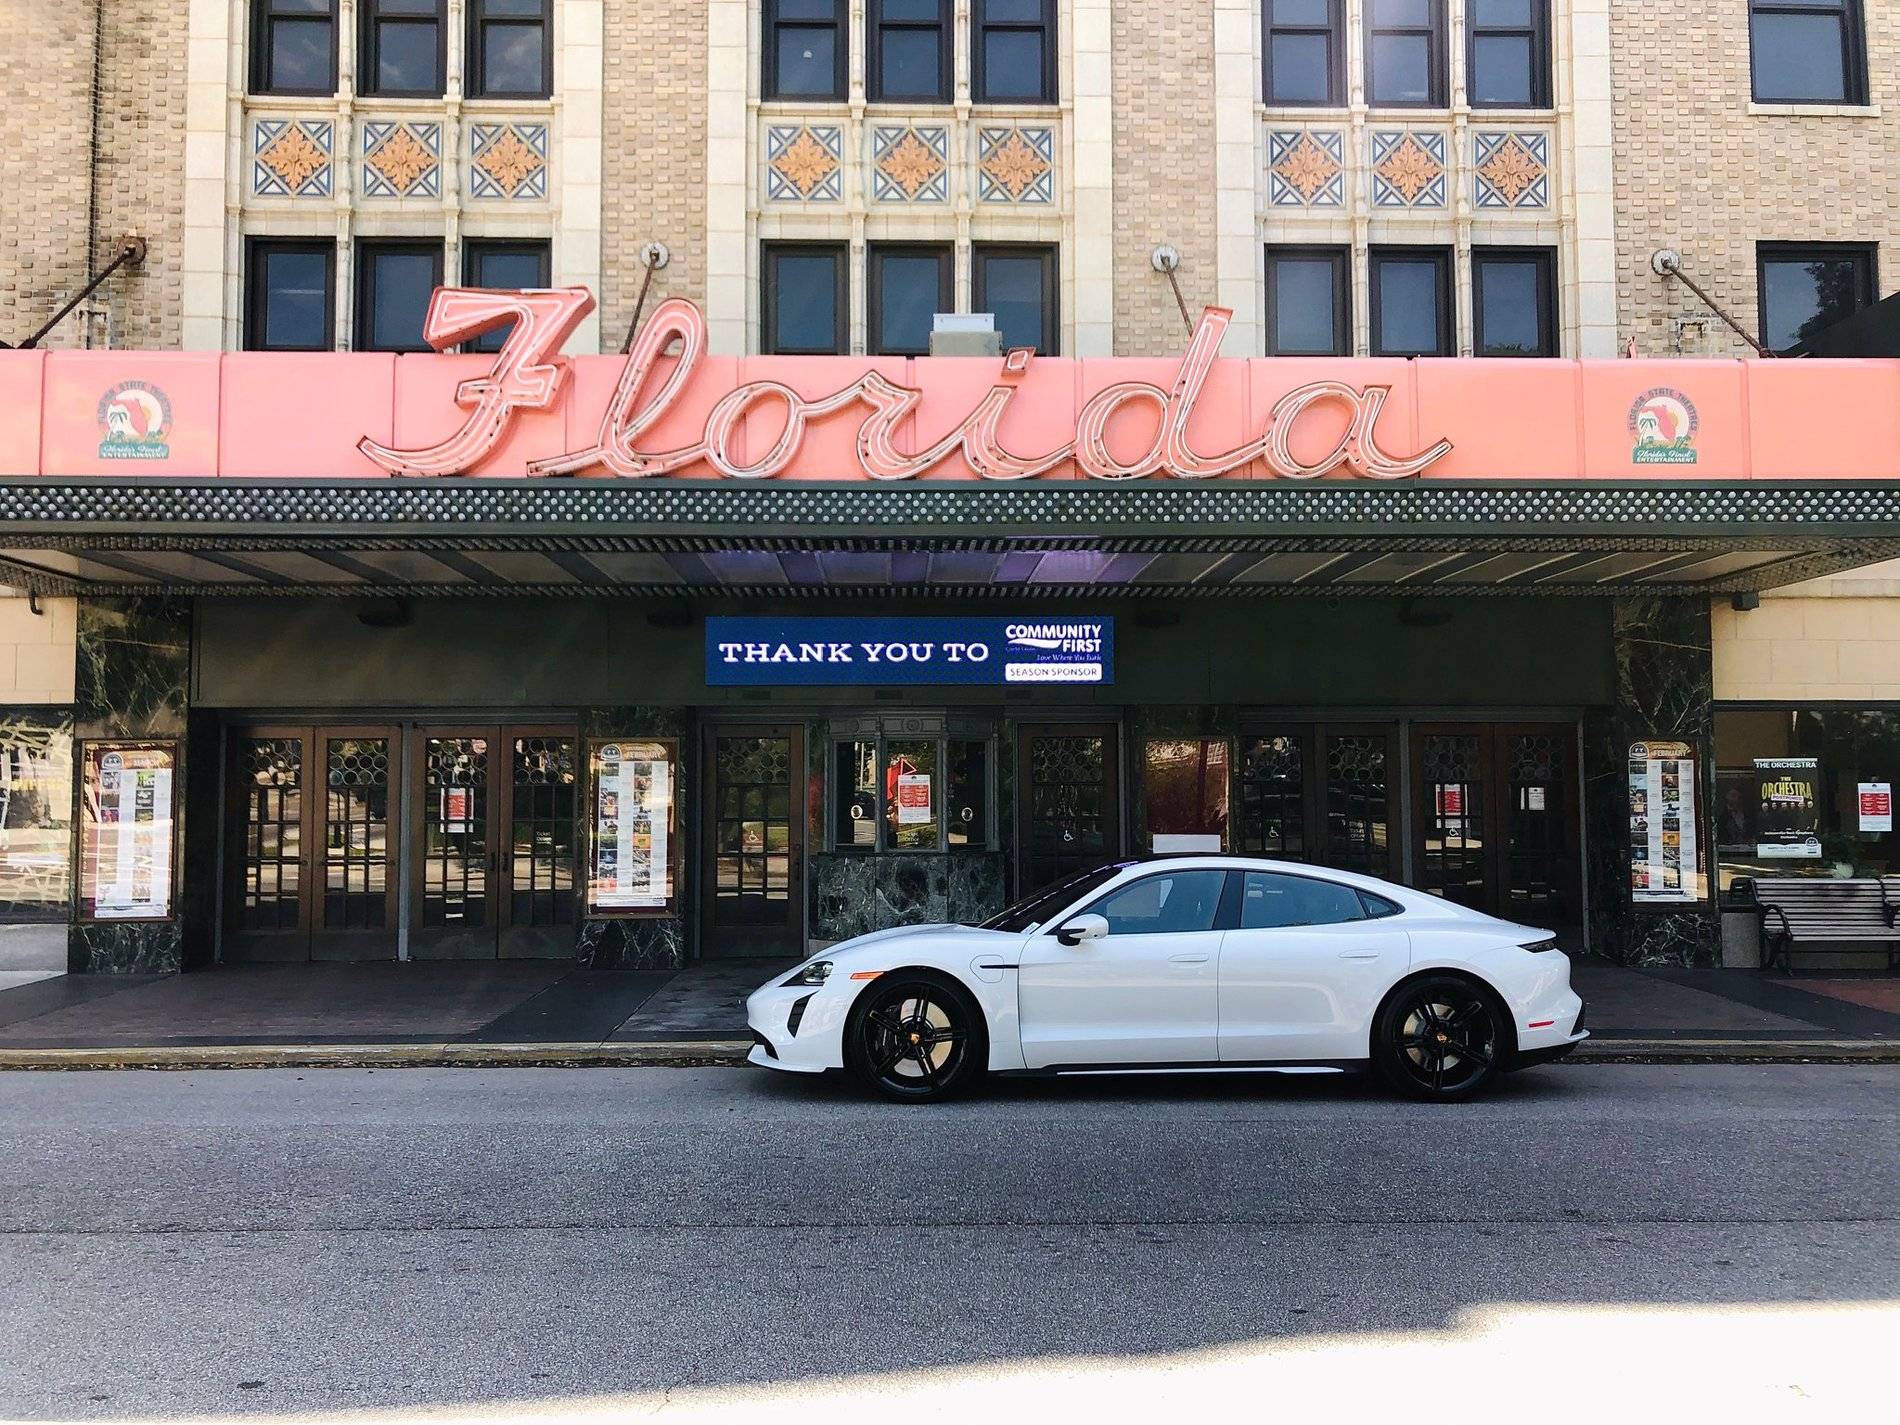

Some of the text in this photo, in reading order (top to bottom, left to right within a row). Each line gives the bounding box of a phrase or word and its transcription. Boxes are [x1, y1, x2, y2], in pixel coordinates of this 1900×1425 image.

[356, 286, 1454, 481] Florida
[1005, 624, 1102, 639] COMMUNITY
[718, 642, 989, 663] THANK YOU TO
[1062, 639, 1102, 653] FIRST
[1010, 667, 1097, 676] SEASON SPONSOR
[1761, 782, 1814, 801] ORCHESTRA
